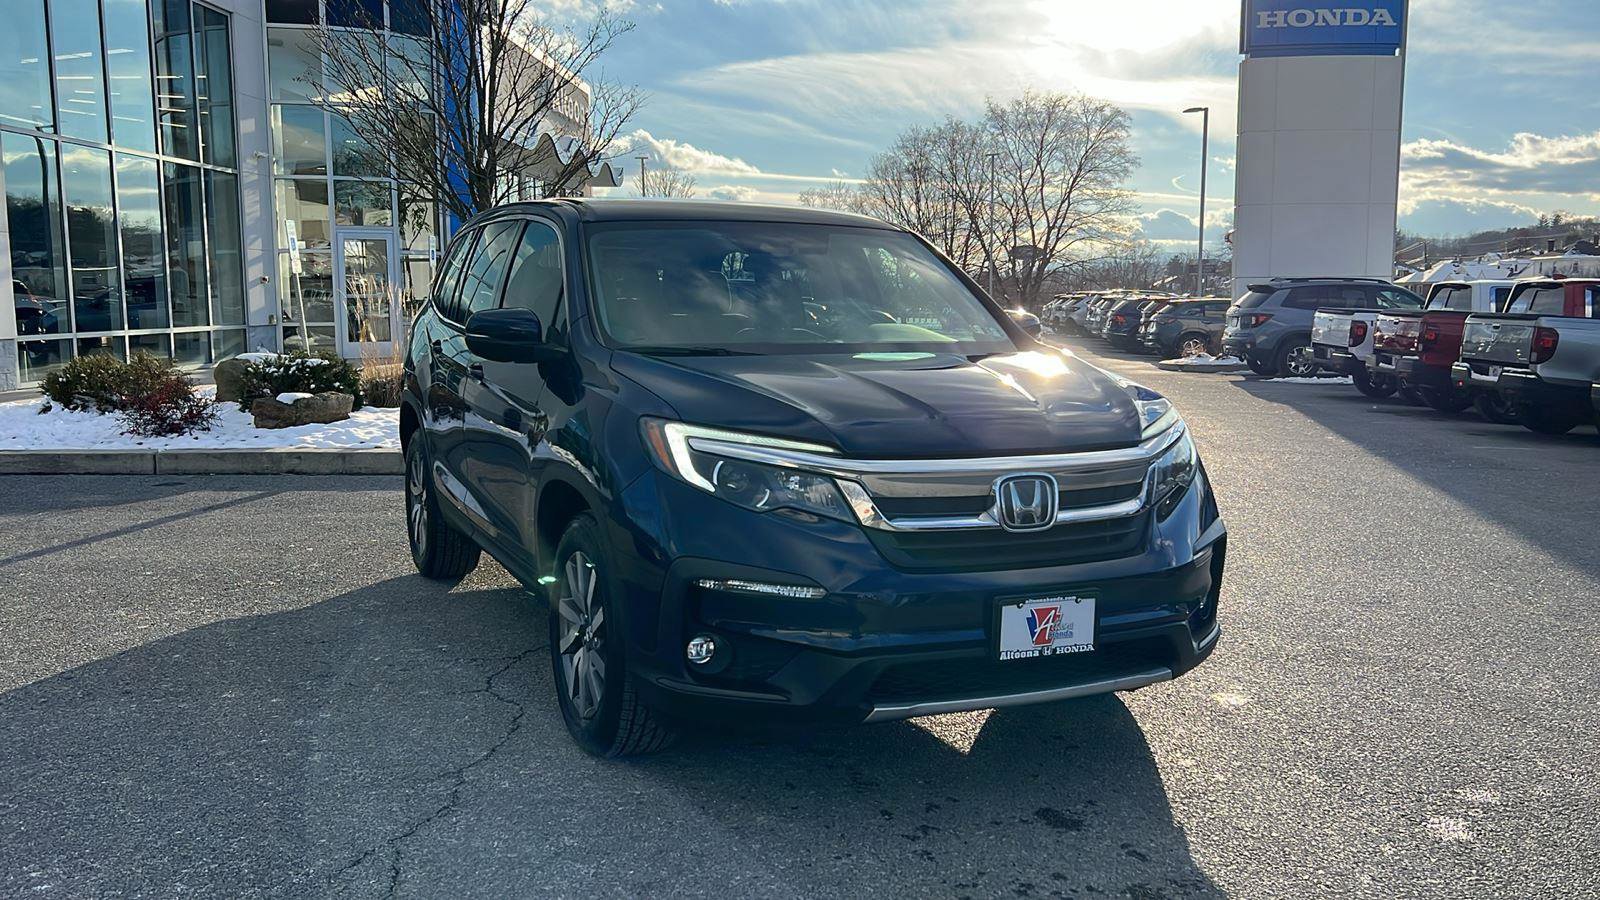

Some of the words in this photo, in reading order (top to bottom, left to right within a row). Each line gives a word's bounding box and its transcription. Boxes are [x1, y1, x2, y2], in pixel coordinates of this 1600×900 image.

[1256, 8, 1398, 29] HONDA
[1000, 649, 1040, 661] Altoona
[1055, 643, 1095, 655] HONDA
